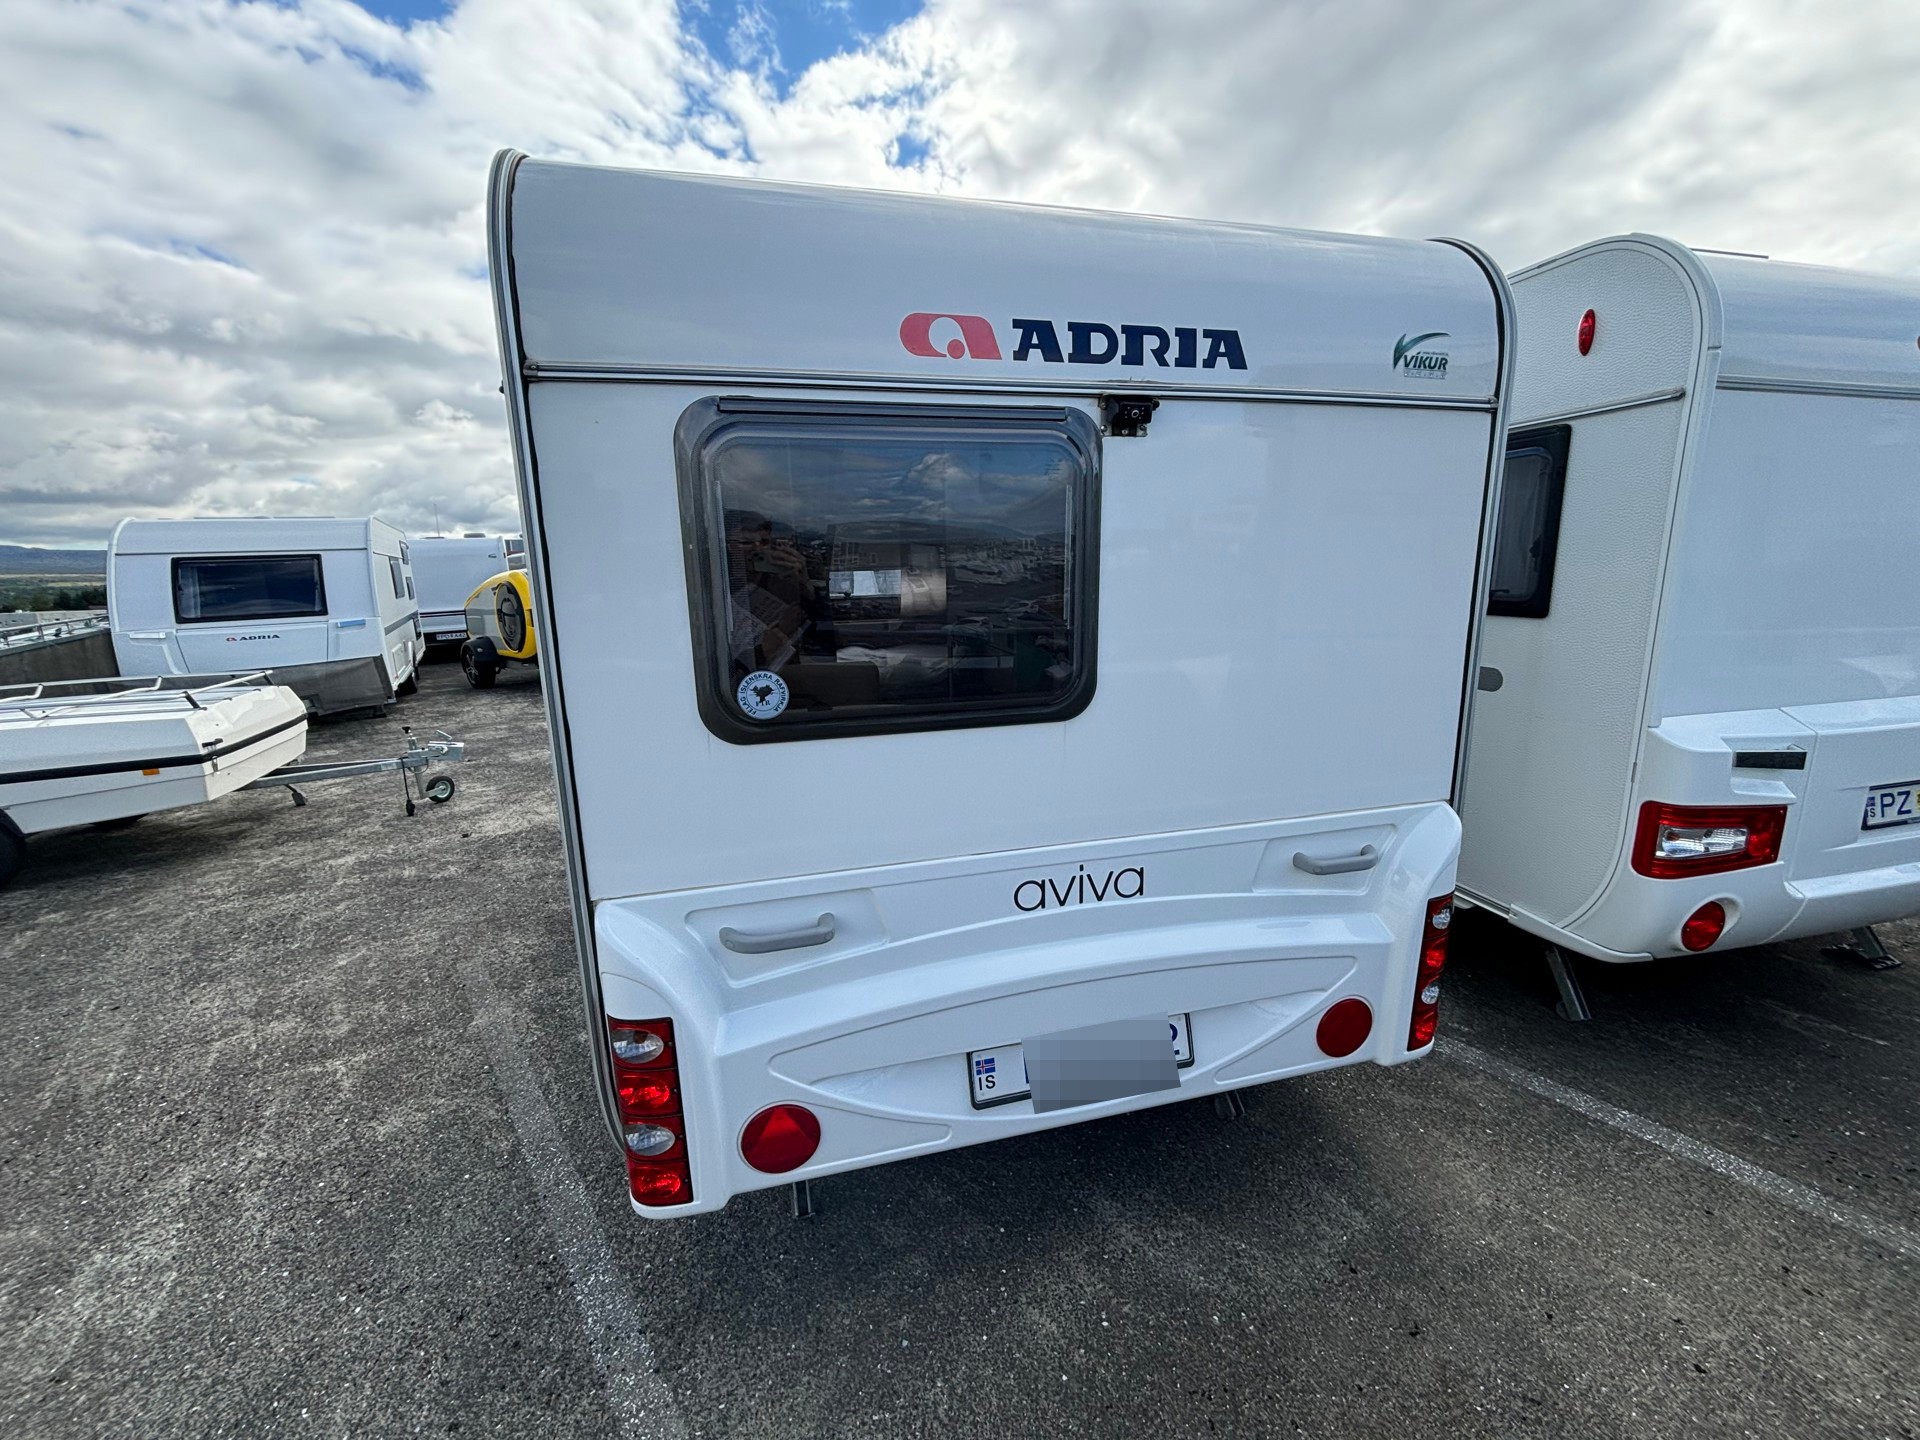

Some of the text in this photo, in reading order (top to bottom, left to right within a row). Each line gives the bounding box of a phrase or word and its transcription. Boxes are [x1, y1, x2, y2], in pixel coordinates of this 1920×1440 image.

[1012, 318, 1248, 370] ADRIA
[1404, 351, 1448, 370] VÍKUR
[1880, 790, 1912, 818] PZ
[1013, 864, 1144, 911] aviva
[978, 1074, 996, 1091] IS
